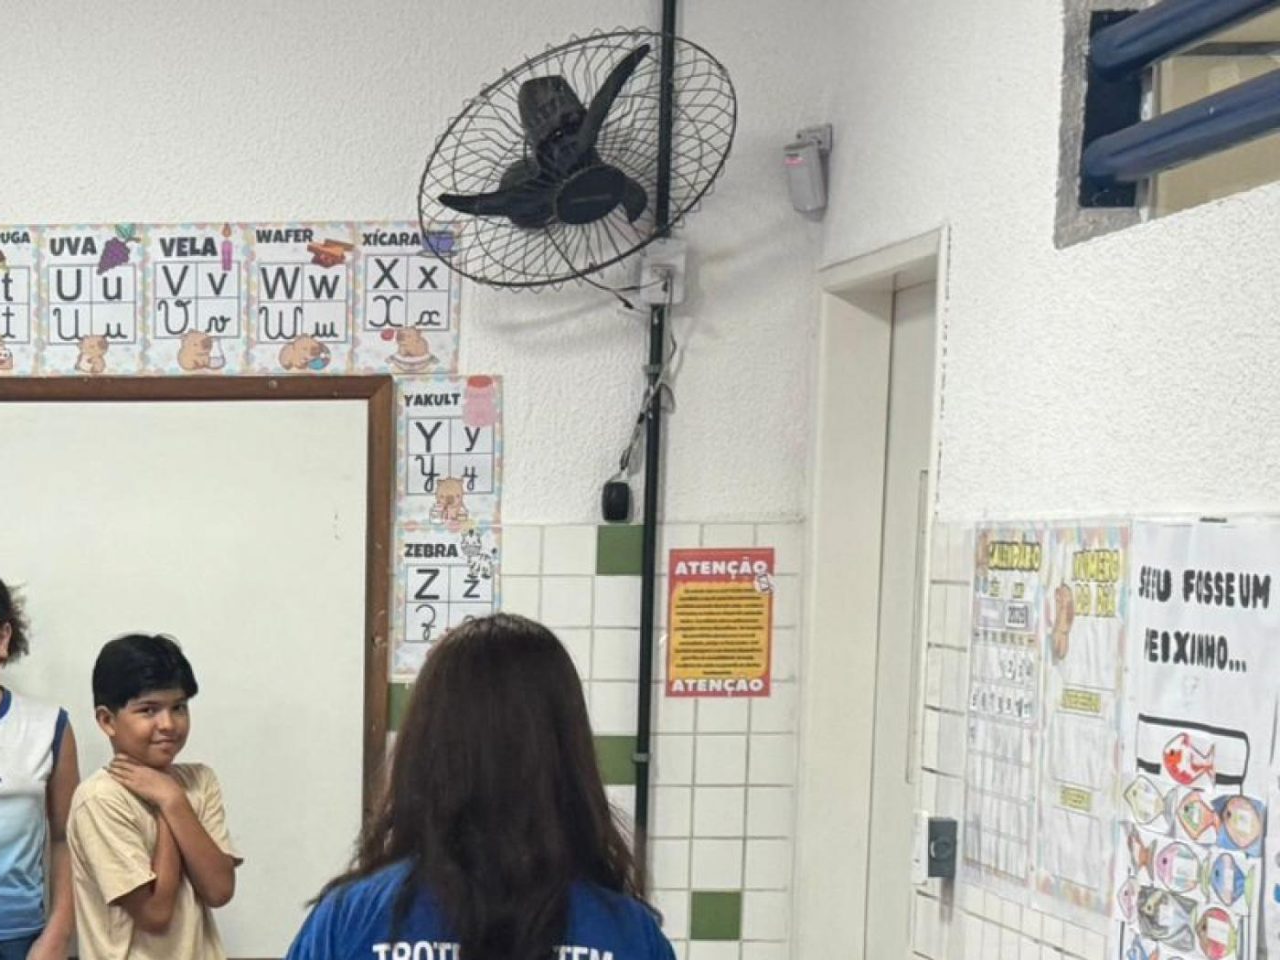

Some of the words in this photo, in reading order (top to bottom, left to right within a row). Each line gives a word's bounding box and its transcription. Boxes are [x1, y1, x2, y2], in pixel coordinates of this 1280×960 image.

[49, 237, 97, 256] UVA
[159, 237, 217, 257] VELA
[256, 229, 313, 243] WAFER
[363, 229, 421, 246] XÍCARA
[57, 269, 81, 301] U
[103, 276, 122, 300] u
[162, 265, 189, 296] V
[208, 273, 227, 296] v
[261, 267, 300, 299] W
[309, 275, 339, 299] w
[373, 258, 399, 289] X
[418, 266, 438, 289] x
[1, 272, 13, 302] t
[404, 393, 461, 407] YAKULT
[415, 421, 442, 453] Y
[464, 426, 481, 452] y
[404, 543, 458, 558] ZEBRA
[675, 556, 767, 579] ATENÇÃO
[414, 568, 440, 600] Z
[463, 579, 481, 598] z
[671, 676, 765, 697] ATENÇÃO
